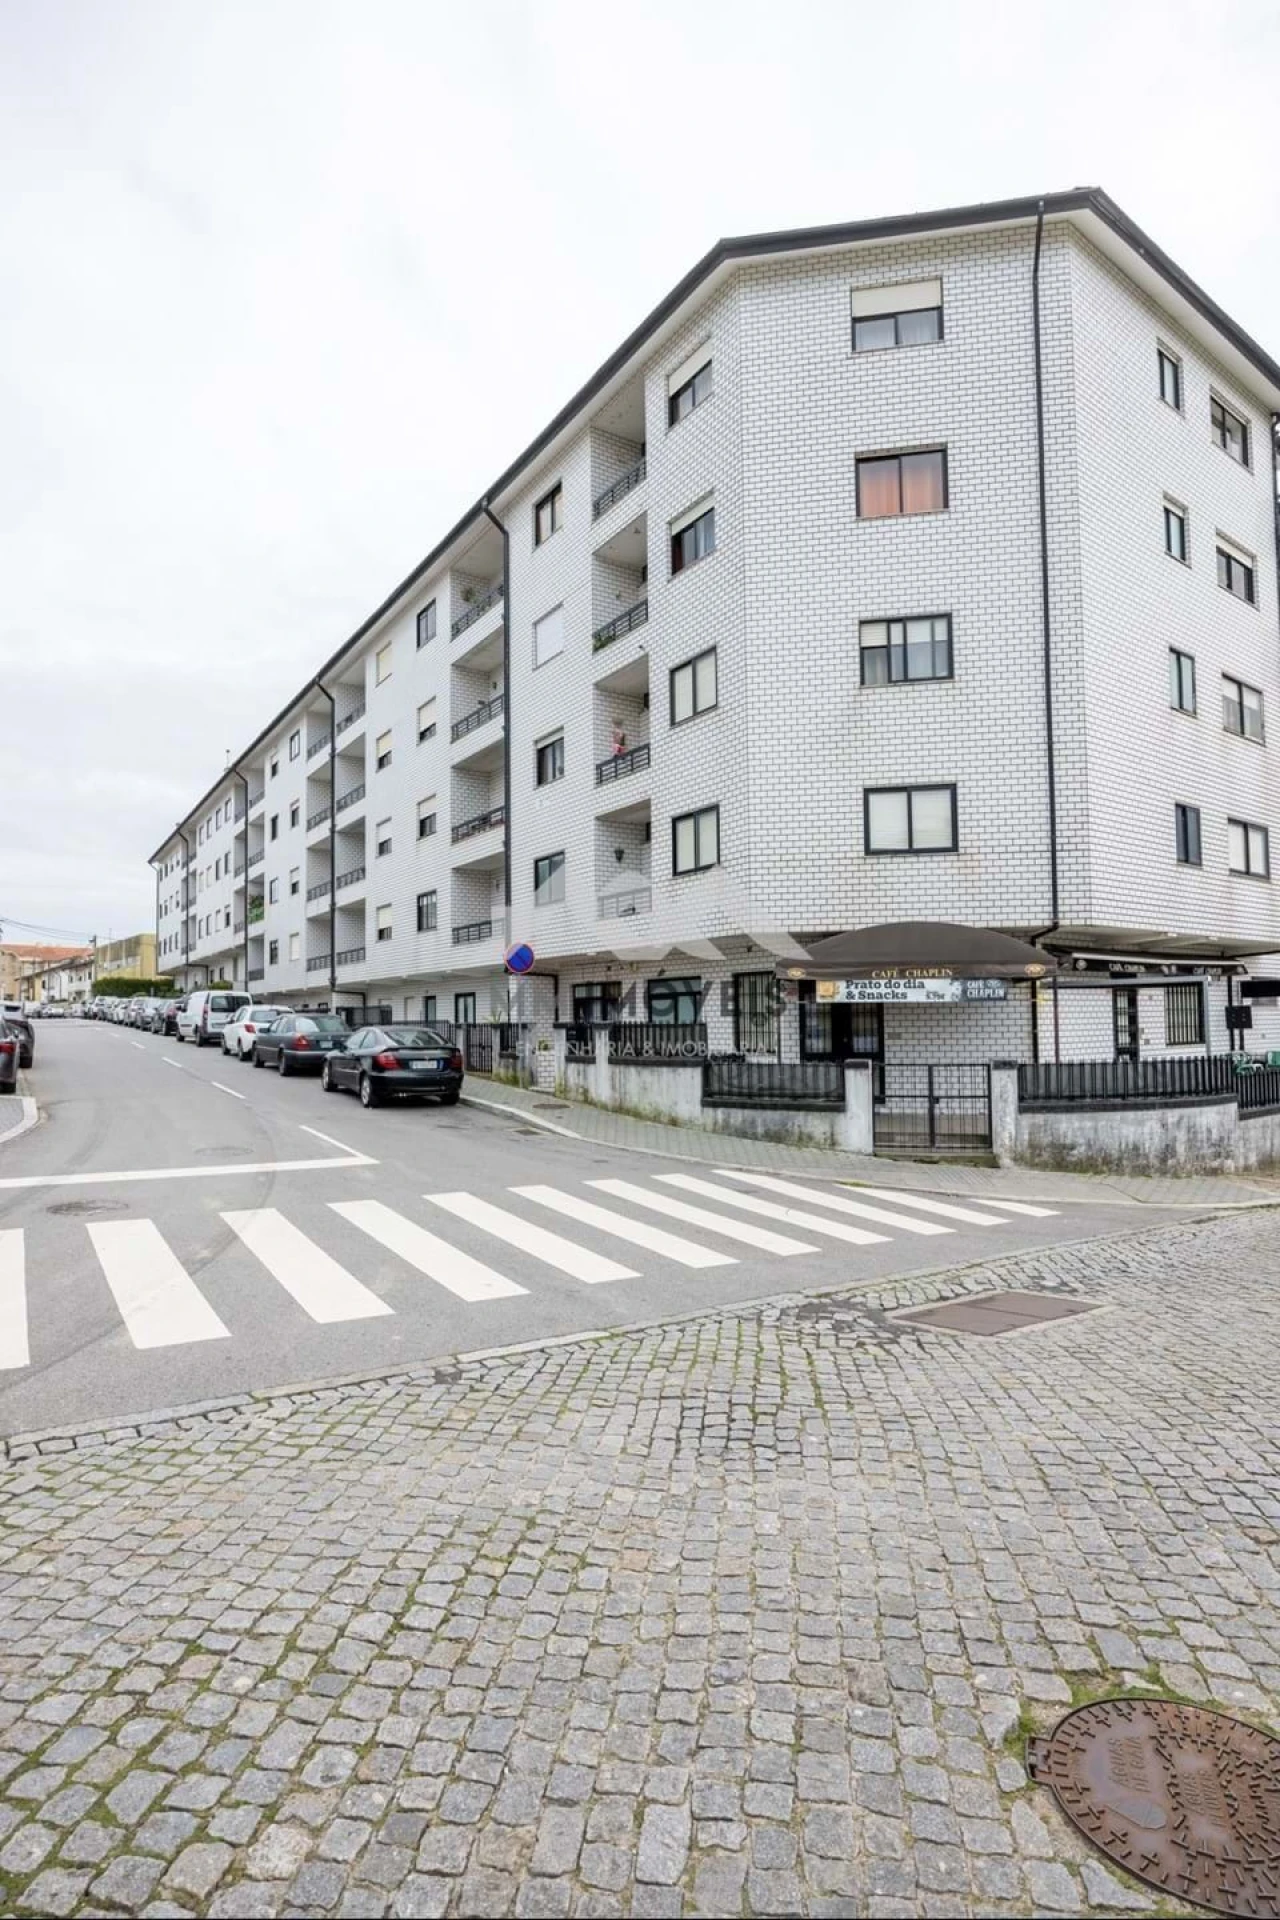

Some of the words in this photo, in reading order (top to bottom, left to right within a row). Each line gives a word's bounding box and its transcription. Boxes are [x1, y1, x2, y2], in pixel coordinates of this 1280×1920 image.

[906, 968, 953, 978] CHAPLIN
[845, 980, 881, 989] Prato
[884, 980, 900, 989] do
[903, 980, 925, 989] dia
[846, 991, 855, 1000] &
[858, 990, 908, 1000] Snacks
[967, 988, 1005, 998] CHAPLIN
